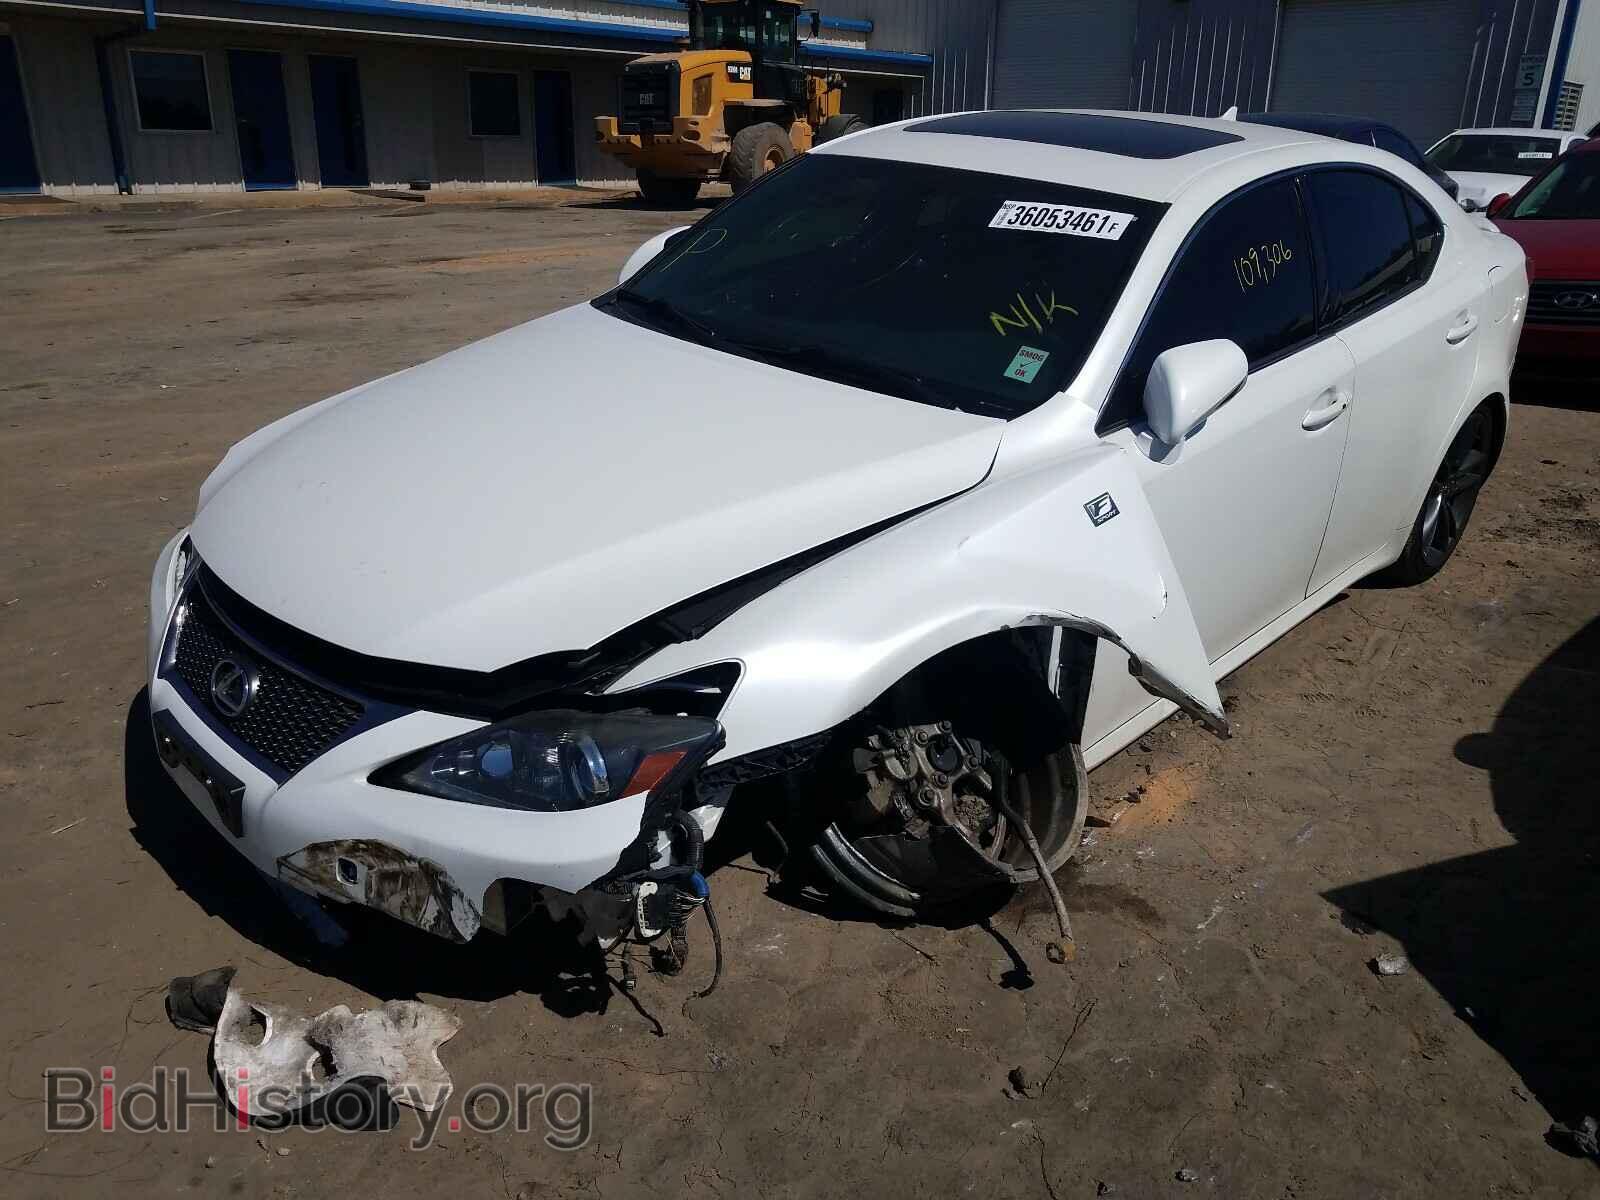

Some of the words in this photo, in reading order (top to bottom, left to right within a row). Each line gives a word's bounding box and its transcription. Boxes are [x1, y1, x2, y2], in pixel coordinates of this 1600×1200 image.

[739, 66, 752, 81] CAT
[1522, 72, 1535, 86] 5
[1007, 205, 1111, 234] 36053461
[1108, 222, 1119, 233] F
[989, 288, 1080, 336] N/K
